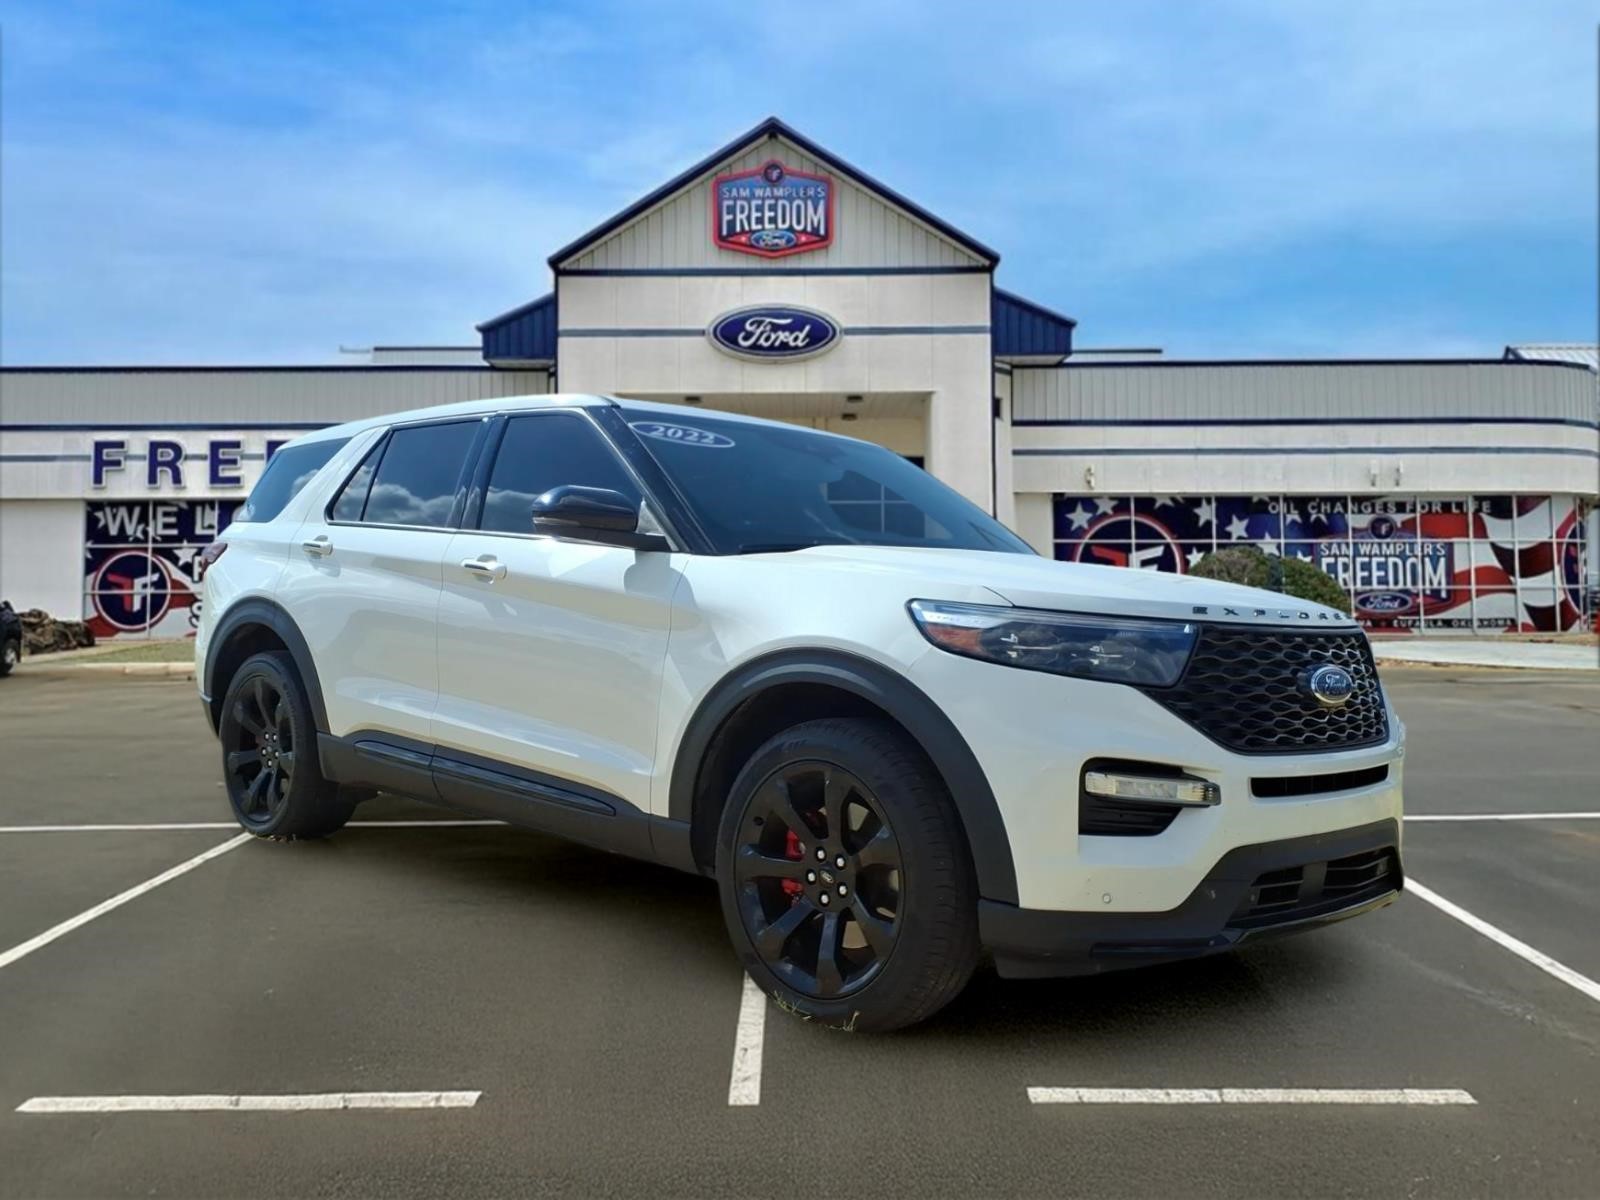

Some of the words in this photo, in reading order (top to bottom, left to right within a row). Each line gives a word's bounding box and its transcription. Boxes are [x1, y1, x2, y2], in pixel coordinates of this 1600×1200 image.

[722, 187, 750, 198] SAM
[721, 199, 826, 237] FREEDOM
[737, 316, 811, 347] Ford
[650, 425, 715, 444] 2022
[91, 439, 291, 488] FRE
[1268, 502, 1299, 514] OIL
[1307, 500, 1397, 514] CHANGES
[1406, 501, 1443, 514] FOR
[1452, 501, 1491, 513] LIFE
[1320, 557, 1447, 598] FREEDOM
[1366, 595, 1400, 609] Ford
